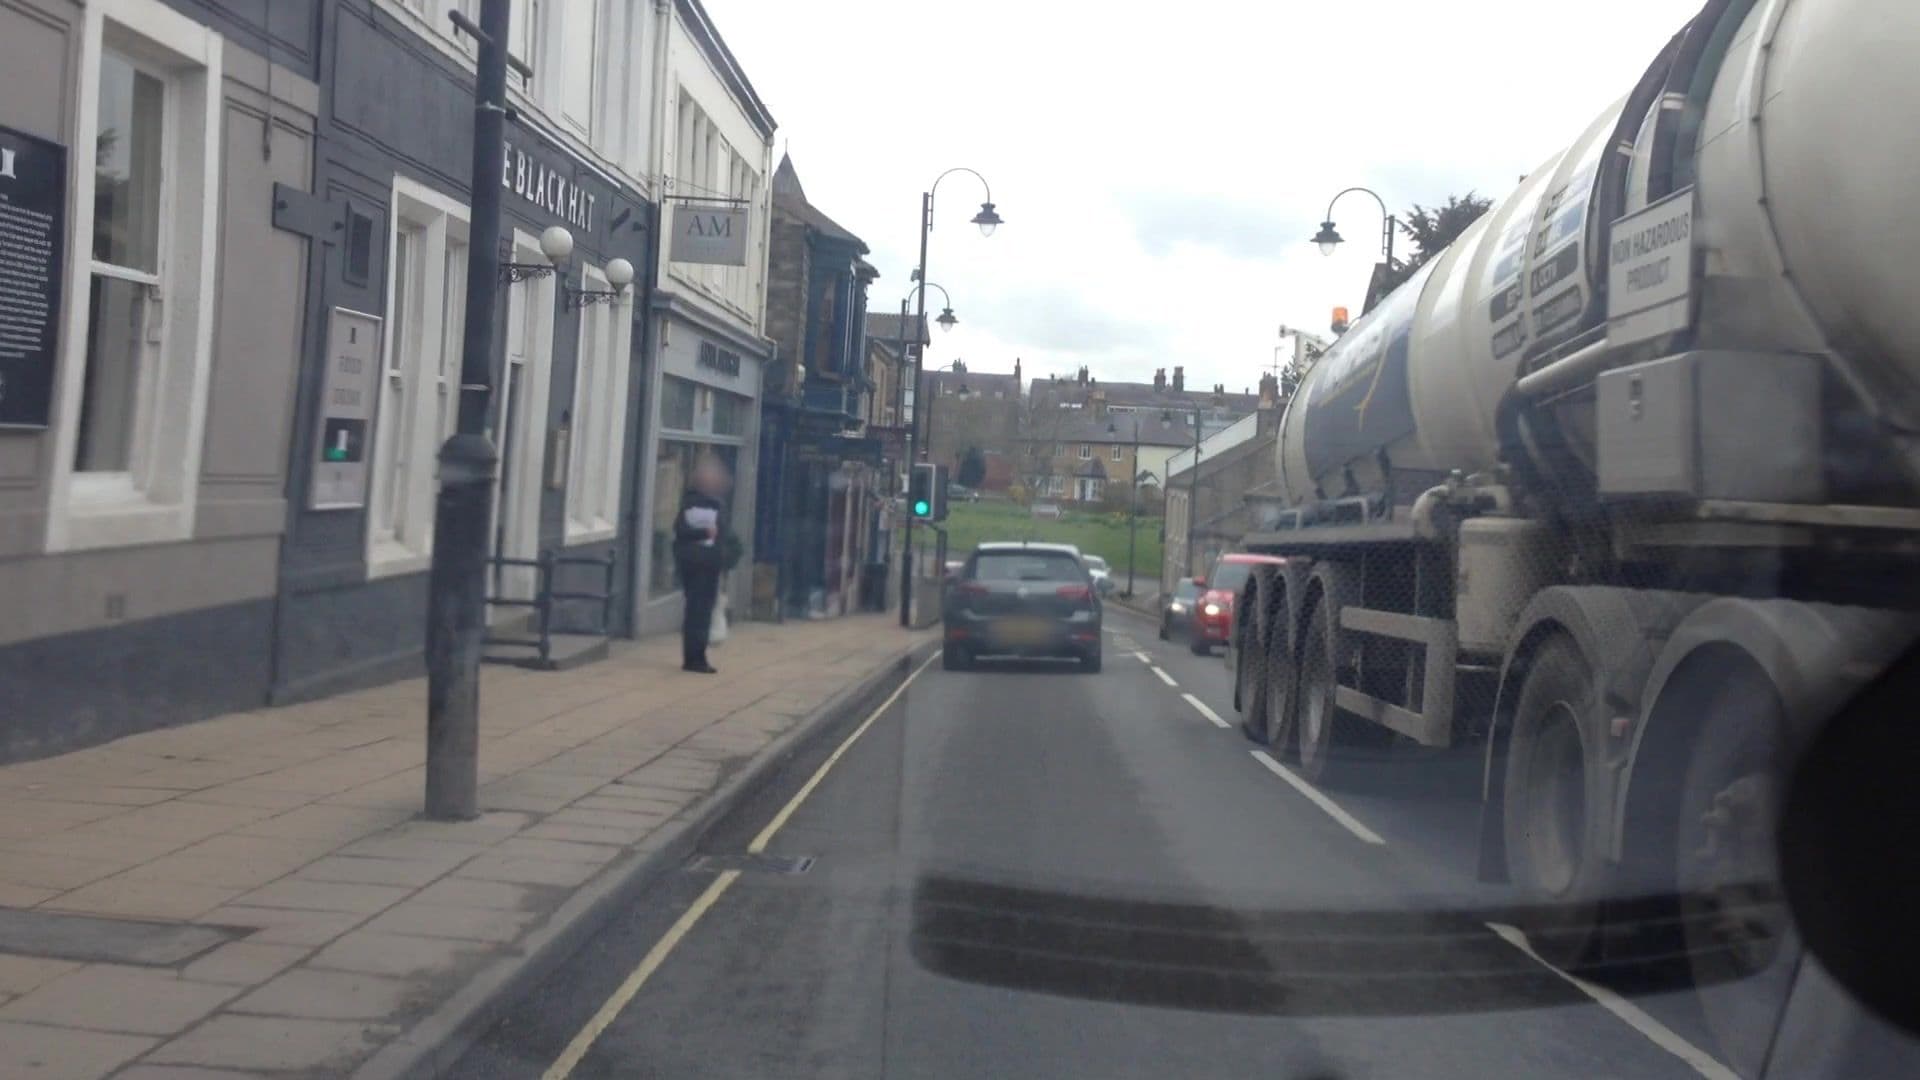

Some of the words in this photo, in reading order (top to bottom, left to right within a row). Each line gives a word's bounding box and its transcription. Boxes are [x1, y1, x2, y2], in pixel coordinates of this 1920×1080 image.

[515, 149, 565, 218] BLACK
[568, 184, 595, 233] HAT
[1612, 238, 1631, 265] NON
[1633, 212, 1689, 257] HAZARDOUS
[1627, 256, 1670, 293] PRODUCT
